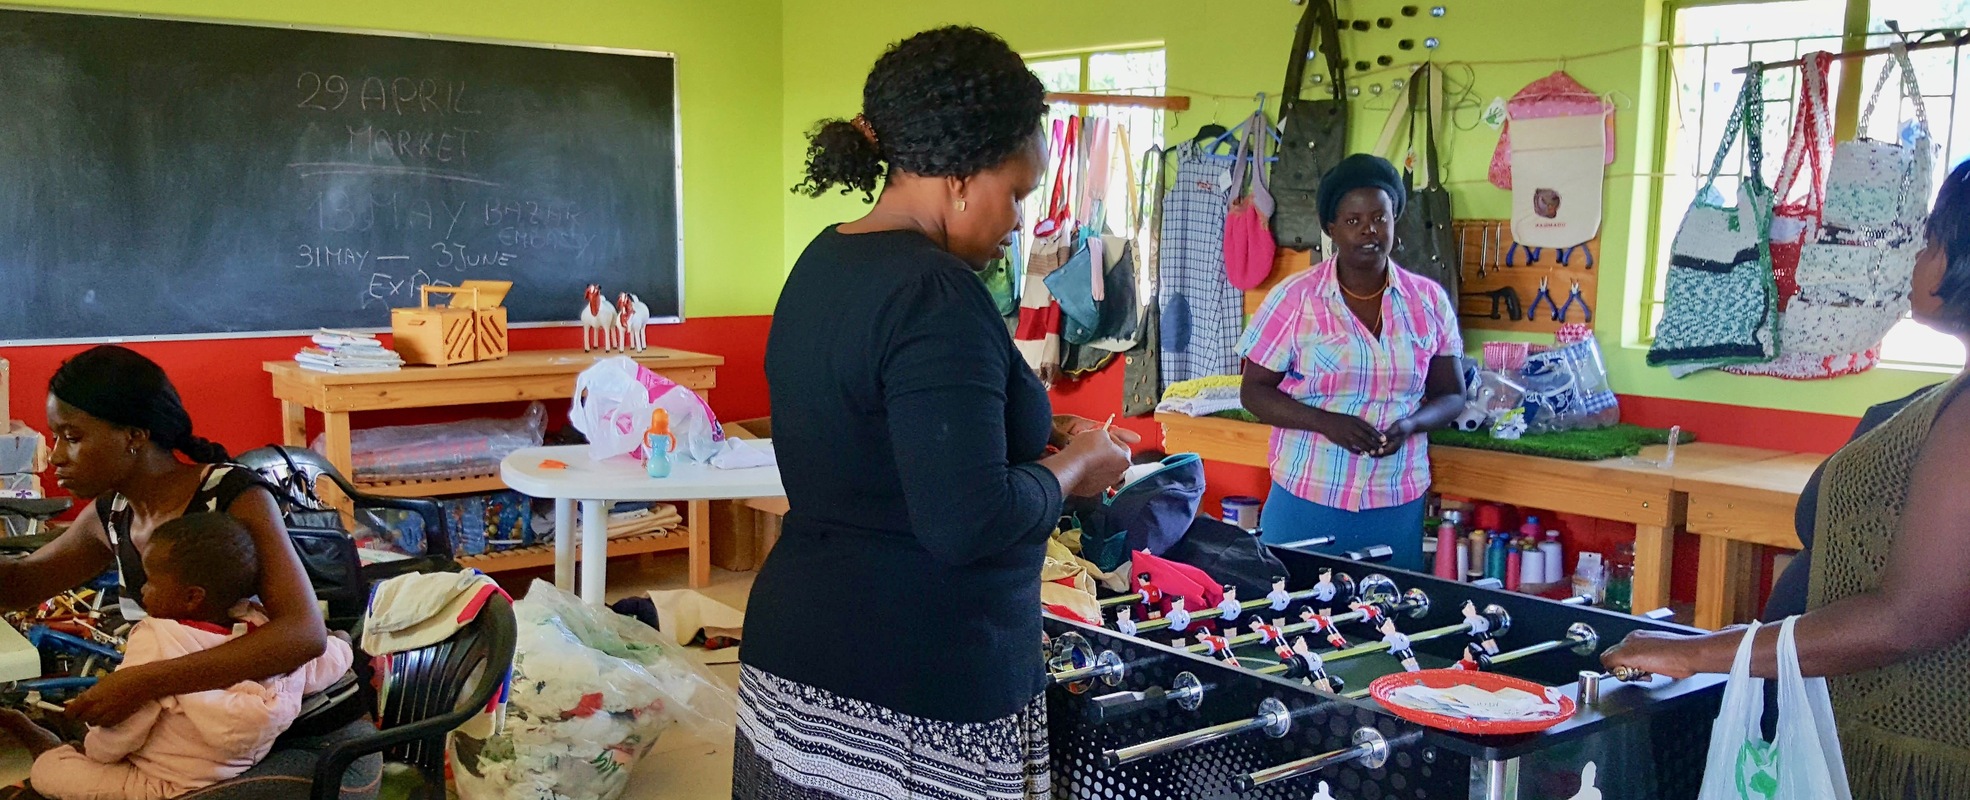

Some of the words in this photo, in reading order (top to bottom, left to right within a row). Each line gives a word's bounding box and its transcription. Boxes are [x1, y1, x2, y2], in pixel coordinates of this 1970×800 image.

[297, 71, 349, 111] 29
[360, 76, 482, 116] APRIL
[345, 124, 480, 162] MARKET
[361, 192, 466, 240] MAY
